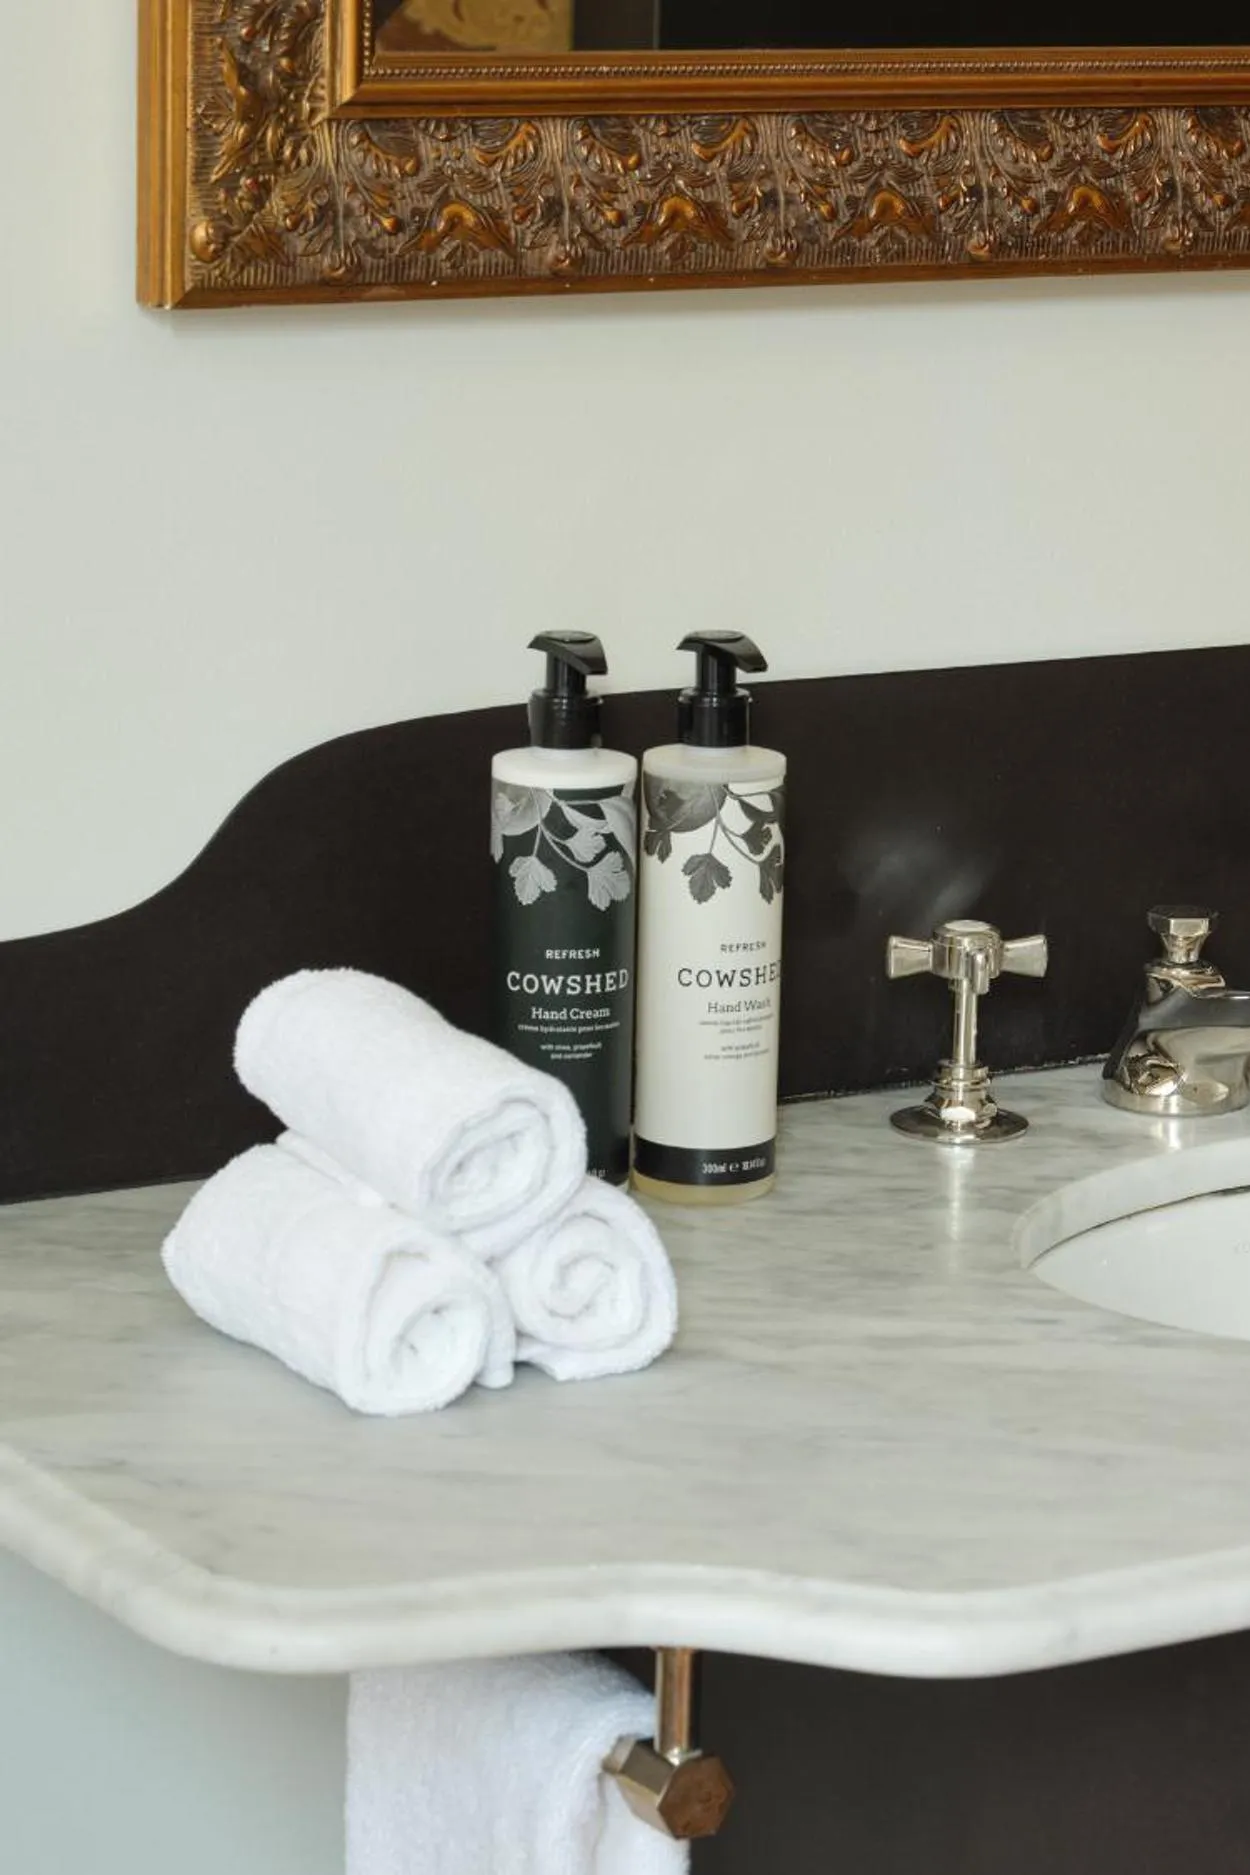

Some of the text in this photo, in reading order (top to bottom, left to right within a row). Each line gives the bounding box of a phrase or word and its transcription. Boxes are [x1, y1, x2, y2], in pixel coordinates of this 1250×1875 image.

[720, 940, 767, 953] REFRESH
[545, 948, 601, 960] REFRESH
[506, 968, 630, 996] COWSHED
[531, 1006, 611, 1020] Hand Cream
[707, 1001, 742, 1014] Hand
